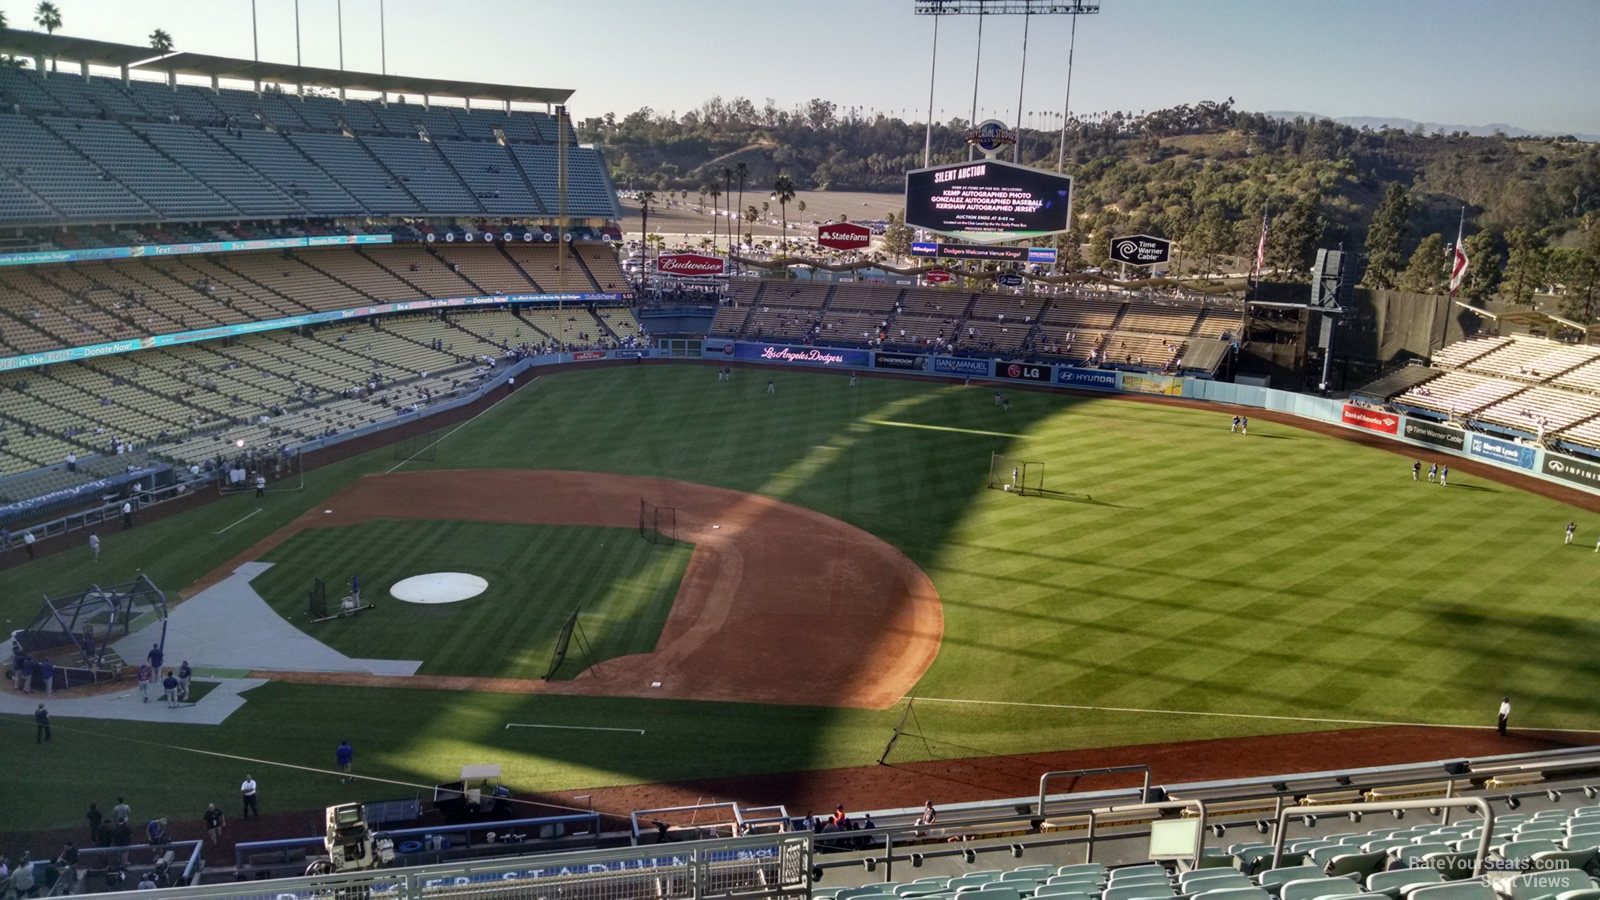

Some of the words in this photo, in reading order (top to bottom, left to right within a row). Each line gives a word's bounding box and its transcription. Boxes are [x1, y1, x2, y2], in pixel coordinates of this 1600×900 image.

[934, 169, 957, 184] SILENT
[958, 164, 986, 180] AUCTION
[155, 246, 170, 254] Text
[661, 258, 722, 271] Budweiser
[84, 346, 112, 356] Donate
[113, 342, 133, 351] Now!
[761, 346, 776, 359] Los
[776, 348, 808, 362] Angeles
[808, 350, 843, 365] Dodgers
[956, 360, 987, 370] MANUEL
[1024, 368, 1040, 378] LG
[1076, 373, 1114, 384] HYUNDAI
[1362, 415, 1382, 425] America
[1413, 426, 1426, 434] Time
[1426, 430, 1446, 440] Warner
[1446, 434, 1463, 443] Cable
[1483, 442, 1501, 453] Merrill
[1502, 447, 1518, 458] Lynch
